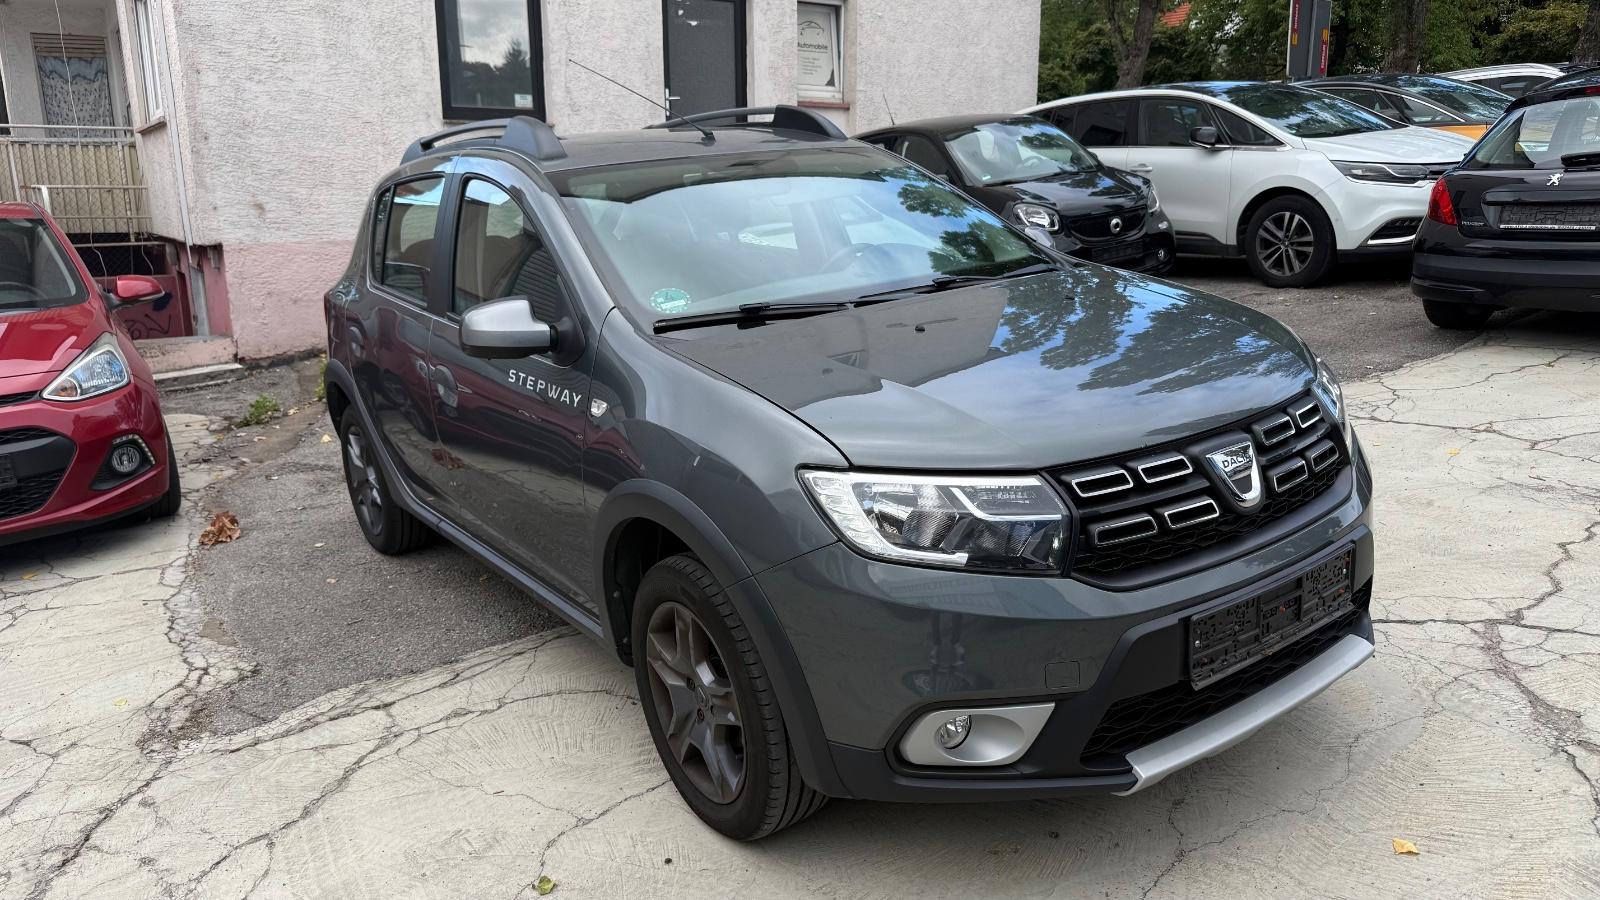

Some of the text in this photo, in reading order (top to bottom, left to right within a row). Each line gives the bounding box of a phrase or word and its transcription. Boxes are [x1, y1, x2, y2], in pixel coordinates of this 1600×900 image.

[797, 42, 828, 50] Automobile
[508, 369, 582, 407] STEPWAY
[1222, 454, 1252, 468] DACIA
